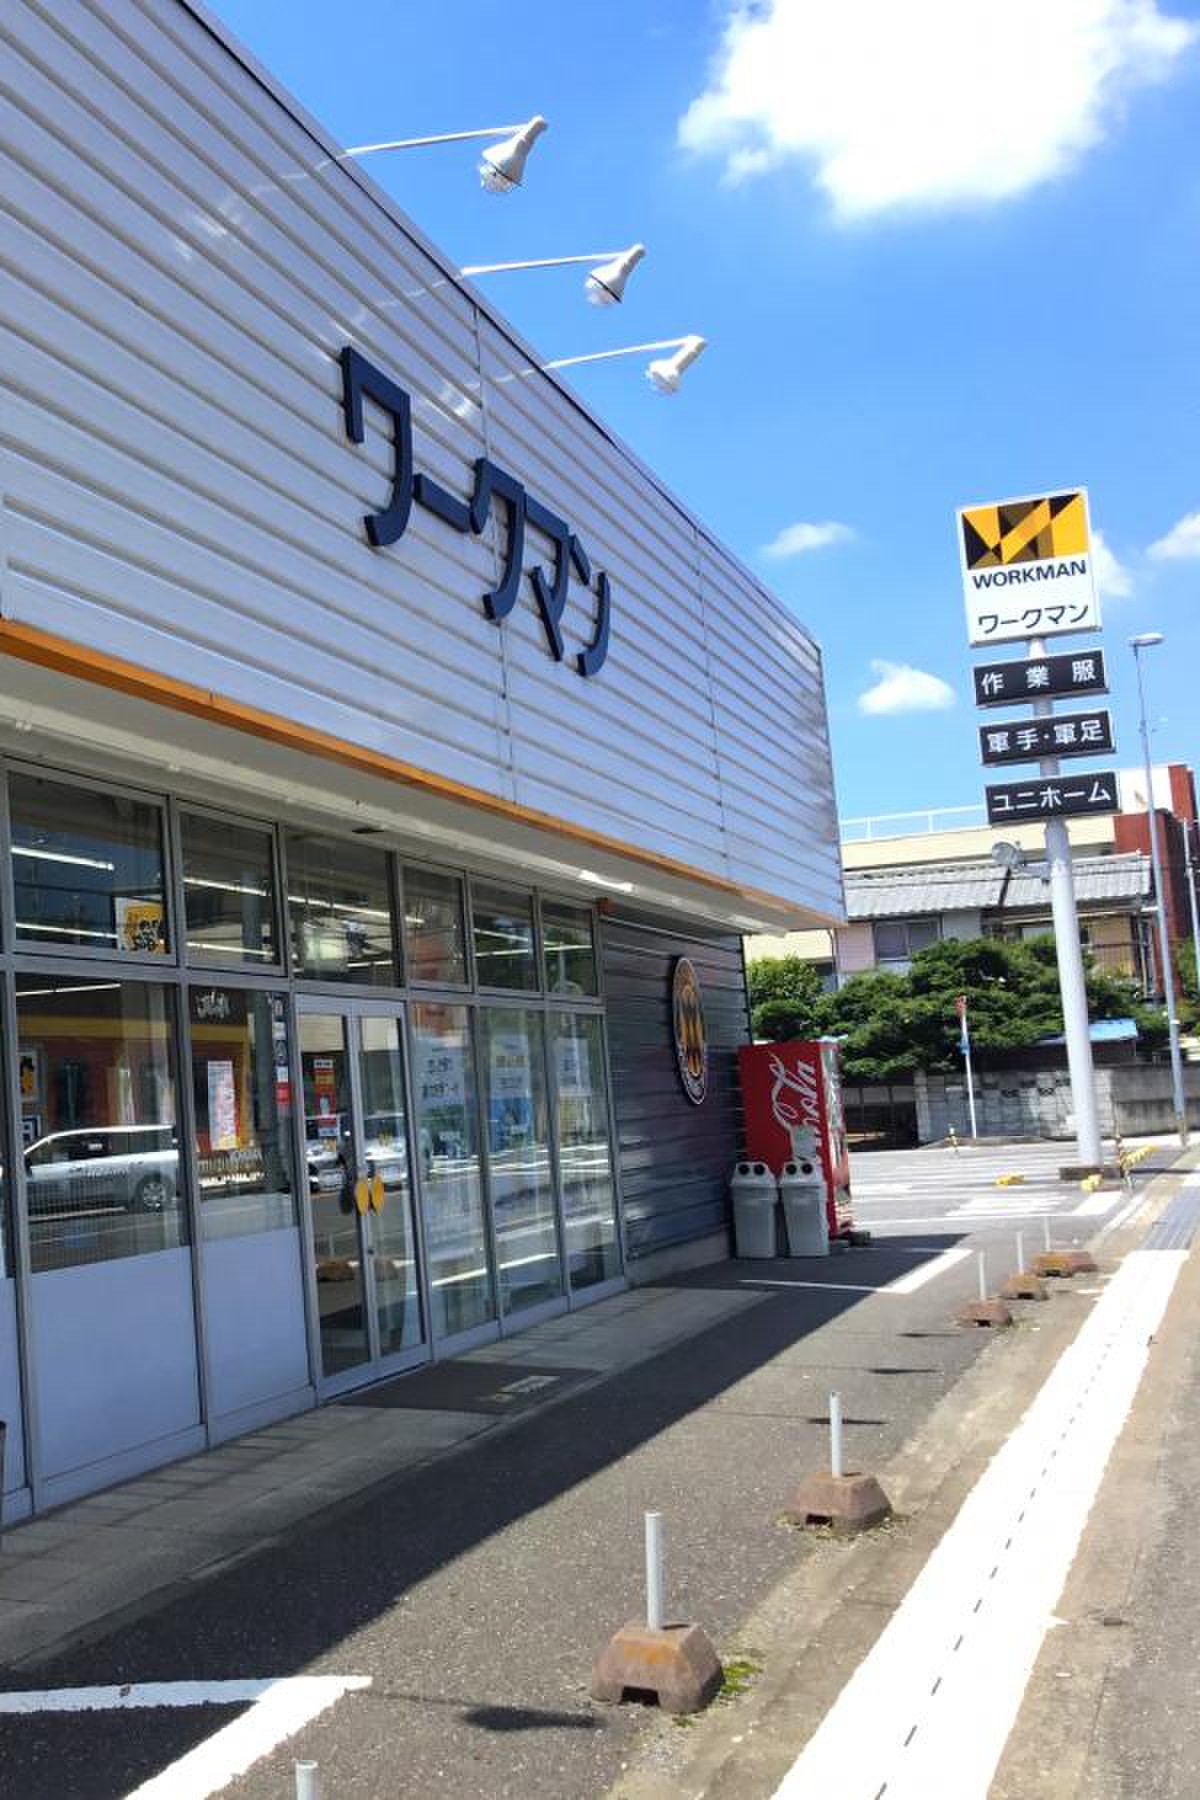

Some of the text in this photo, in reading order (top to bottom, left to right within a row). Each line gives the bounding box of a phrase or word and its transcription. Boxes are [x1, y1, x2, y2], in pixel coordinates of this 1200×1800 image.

[341, 346, 610, 677] ワークマン
[972, 560, 1086, 589] WORKMAN
[978, 605, 1089, 634] ワークマン
[991, 781, 1111, 812] ユニホーム
